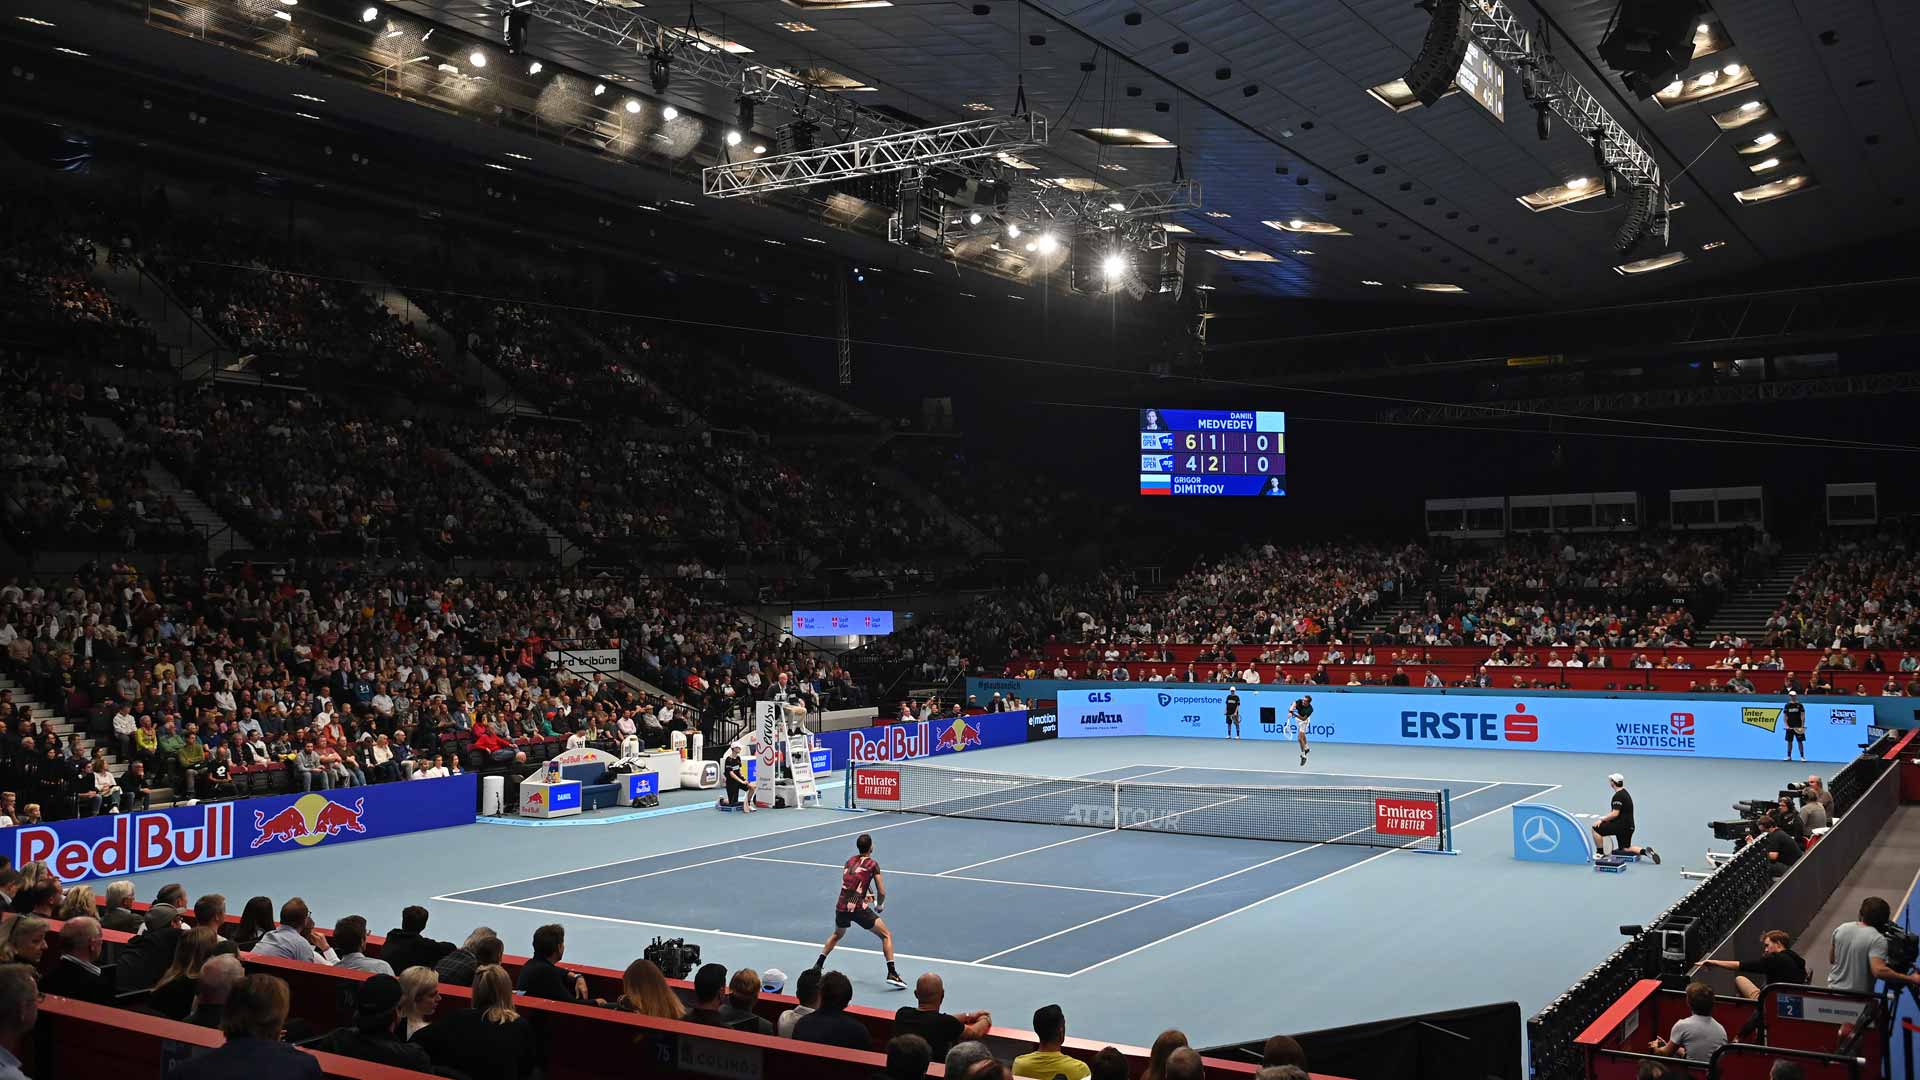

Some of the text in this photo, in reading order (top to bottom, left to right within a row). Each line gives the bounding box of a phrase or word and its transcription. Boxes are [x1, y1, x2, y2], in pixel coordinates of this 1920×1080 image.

[1230, 412, 1254, 420] DANIIL
[1198, 419, 1254, 430] MEDVEDEV
[1185, 434, 1268, 451] 6 1 0
[1185, 455, 1269, 472] 4 2 0
[1174, 476, 1202, 484] GRIGOR
[1174, 484, 1225, 494] DIMITROV
[579, 655, 617, 666] tribüne
[1087, 692, 1112, 703] GLS
[1173, 696, 1223, 704] pepperstone
[1080, 712, 1123, 724] LAVAZZA
[1744, 708, 1763, 717] inter
[1042, 724, 1057, 734] sports
[1401, 711, 1498, 741] ERSTE
[1616, 723, 1669, 735] WIENER
[849, 722, 929, 761] Red Bull
[1616, 735, 1696, 748] STÄDTISCHE
[858, 775, 897, 787] Emirates
[864, 786, 892, 796] FLY BETTER
[1064, 803, 1181, 833] ATP TOUR
[1378, 804, 1433, 820] Emirates
[1387, 818, 1425, 831] FLY BETTER
[18, 803, 233, 881] Red Bull
[1786, 1005, 1794, 1016] 2
